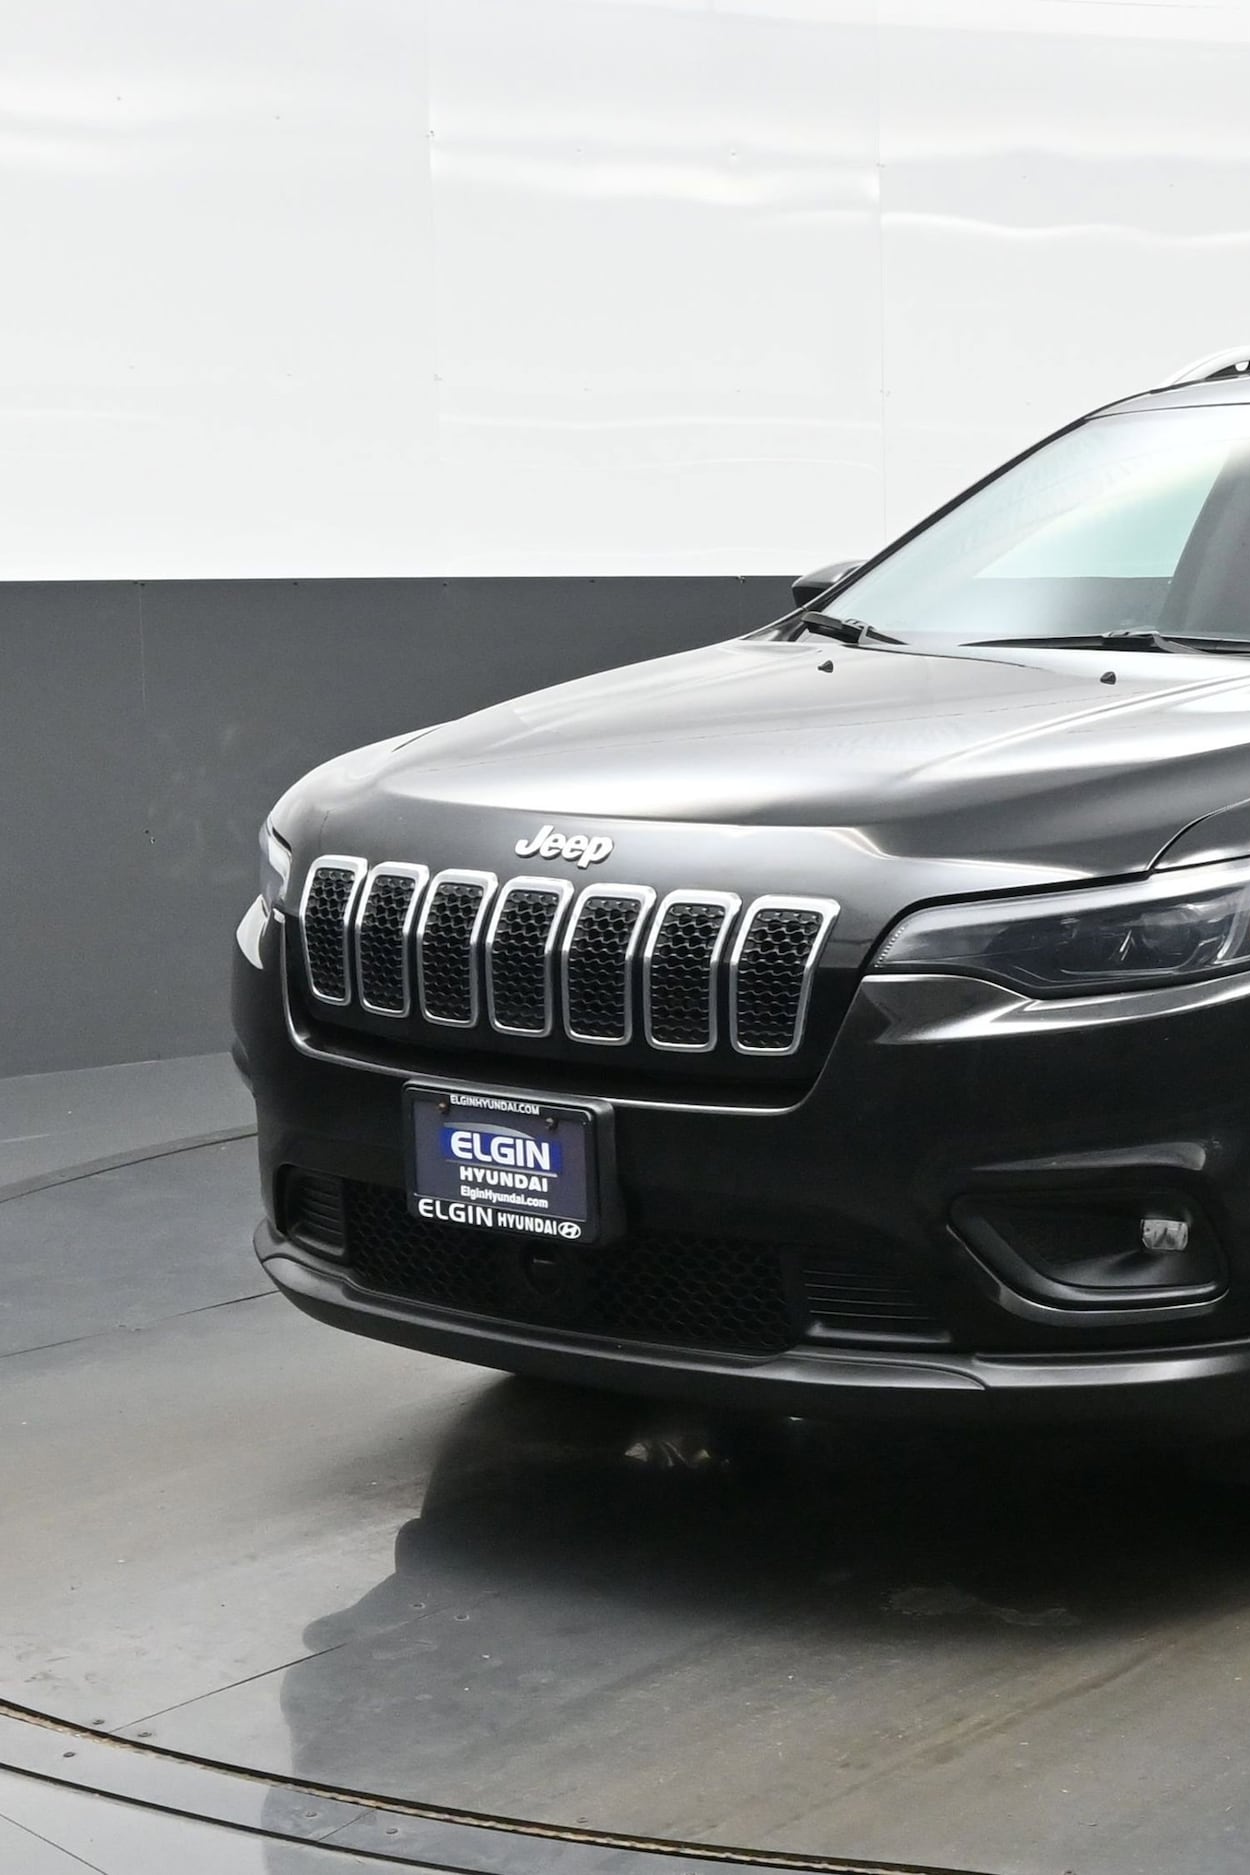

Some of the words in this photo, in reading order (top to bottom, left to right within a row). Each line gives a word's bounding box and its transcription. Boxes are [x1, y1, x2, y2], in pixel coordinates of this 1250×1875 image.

[514, 824, 615, 870] Jeep
[449, 1094, 540, 1116] ELGINHYUNDAI.COM
[450, 1130, 551, 1170] ELGIN
[459, 1166, 549, 1193] HYUNDAI
[460, 1185, 549, 1209] ElginHyundai.com
[417, 1198, 494, 1227] ELGIN
[497, 1211, 558, 1236] HYUNDAI
